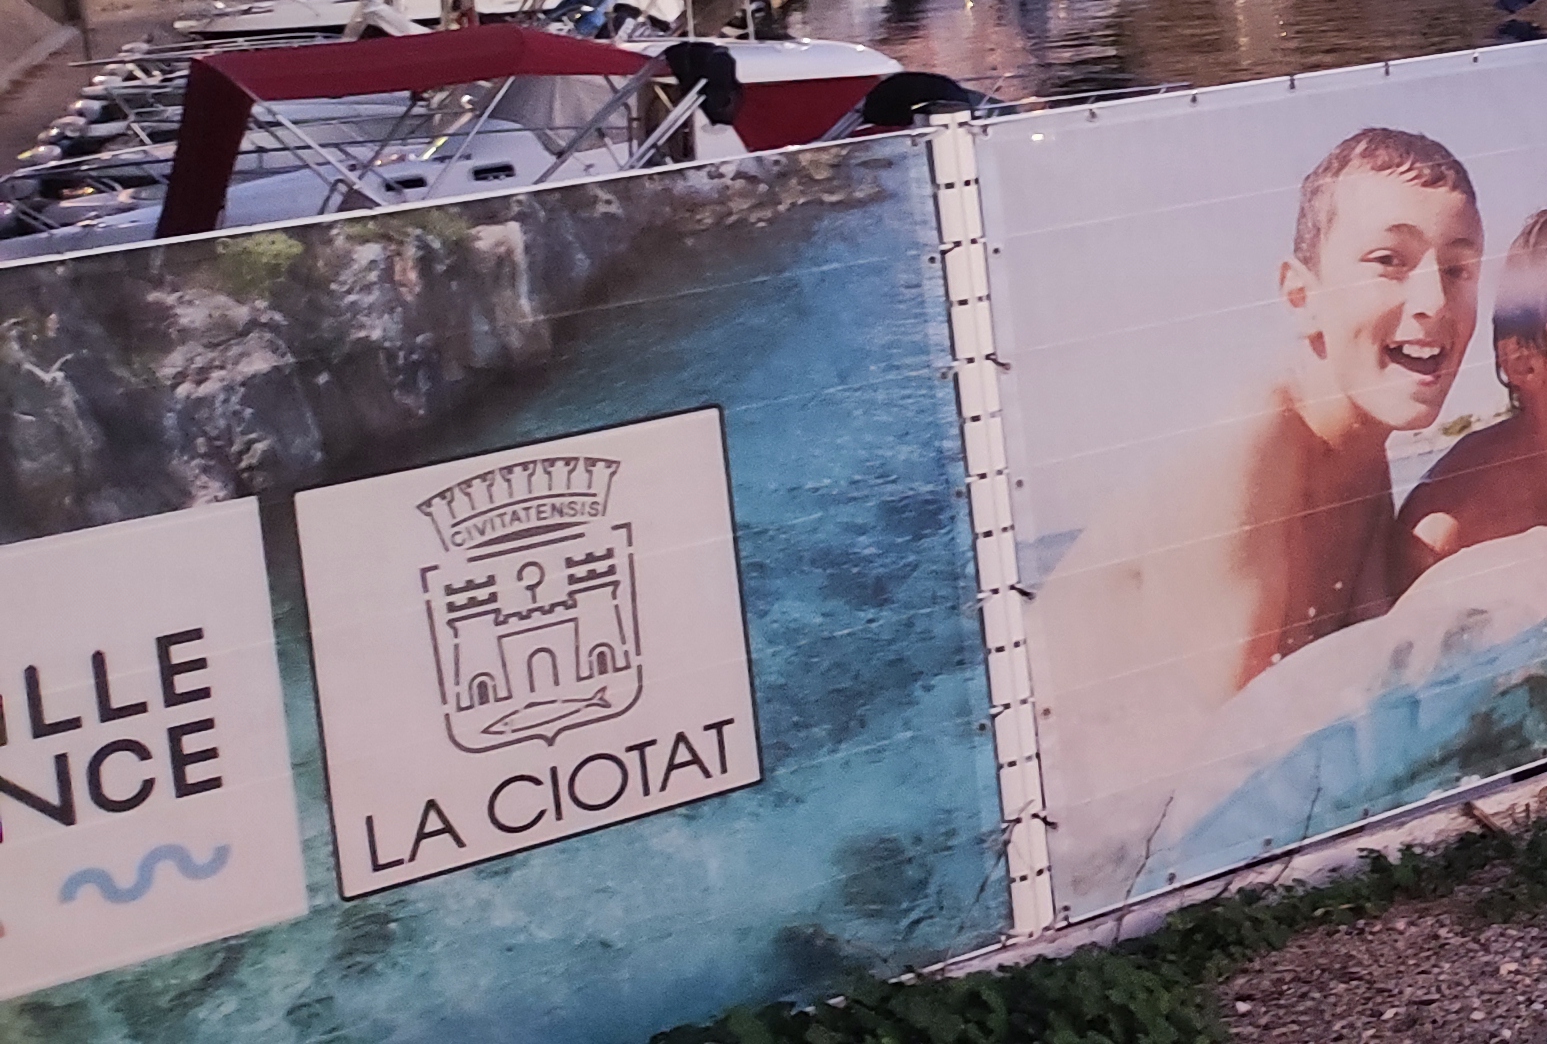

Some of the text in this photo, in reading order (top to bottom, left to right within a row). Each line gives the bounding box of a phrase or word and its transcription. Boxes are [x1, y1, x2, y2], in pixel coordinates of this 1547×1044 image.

[450, 500, 601, 548] CIVITATENSIS
[365, 718, 735, 873] LA CIOTAT
